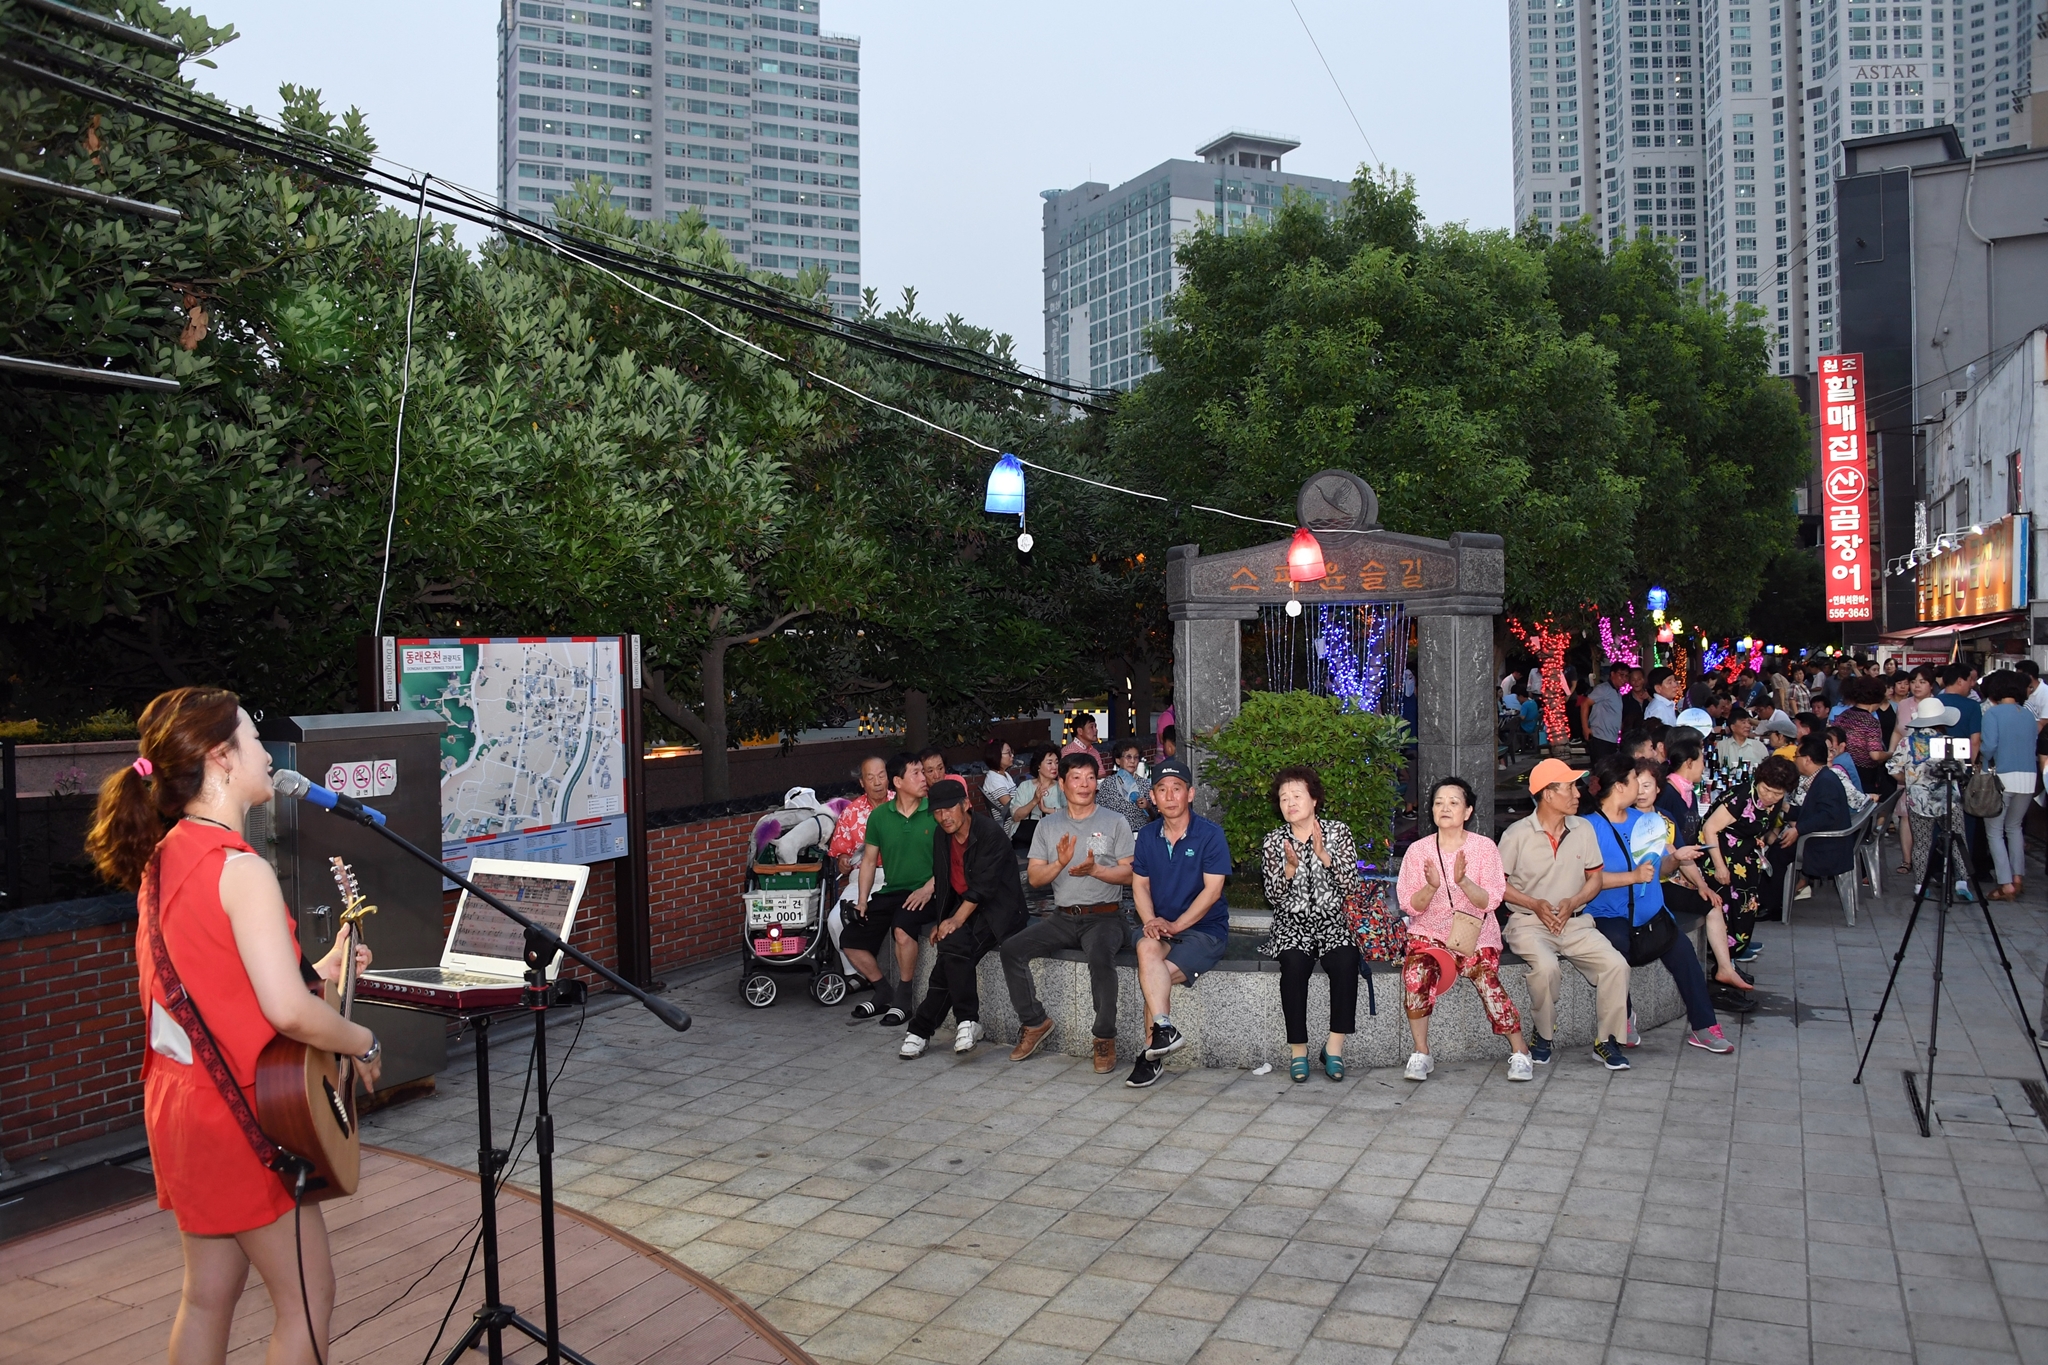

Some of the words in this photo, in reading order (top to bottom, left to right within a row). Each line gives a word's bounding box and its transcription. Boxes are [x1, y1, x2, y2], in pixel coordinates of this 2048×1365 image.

[1855, 64, 1919, 80] ASTAR
[1823, 359, 1858, 373] 원조
[1825, 375, 1859, 462] 할매집
[1828, 469, 1861, 498] 산
[1829, 505, 1864, 591] 곰장어
[1829, 607, 1870, 619] 556-3643
[405, 651, 441, 664] 동래온천
[442, 654, 462, 663] 관광지도
[752, 913, 772, 923] 부산
[776, 911, 802, 922] 0001
